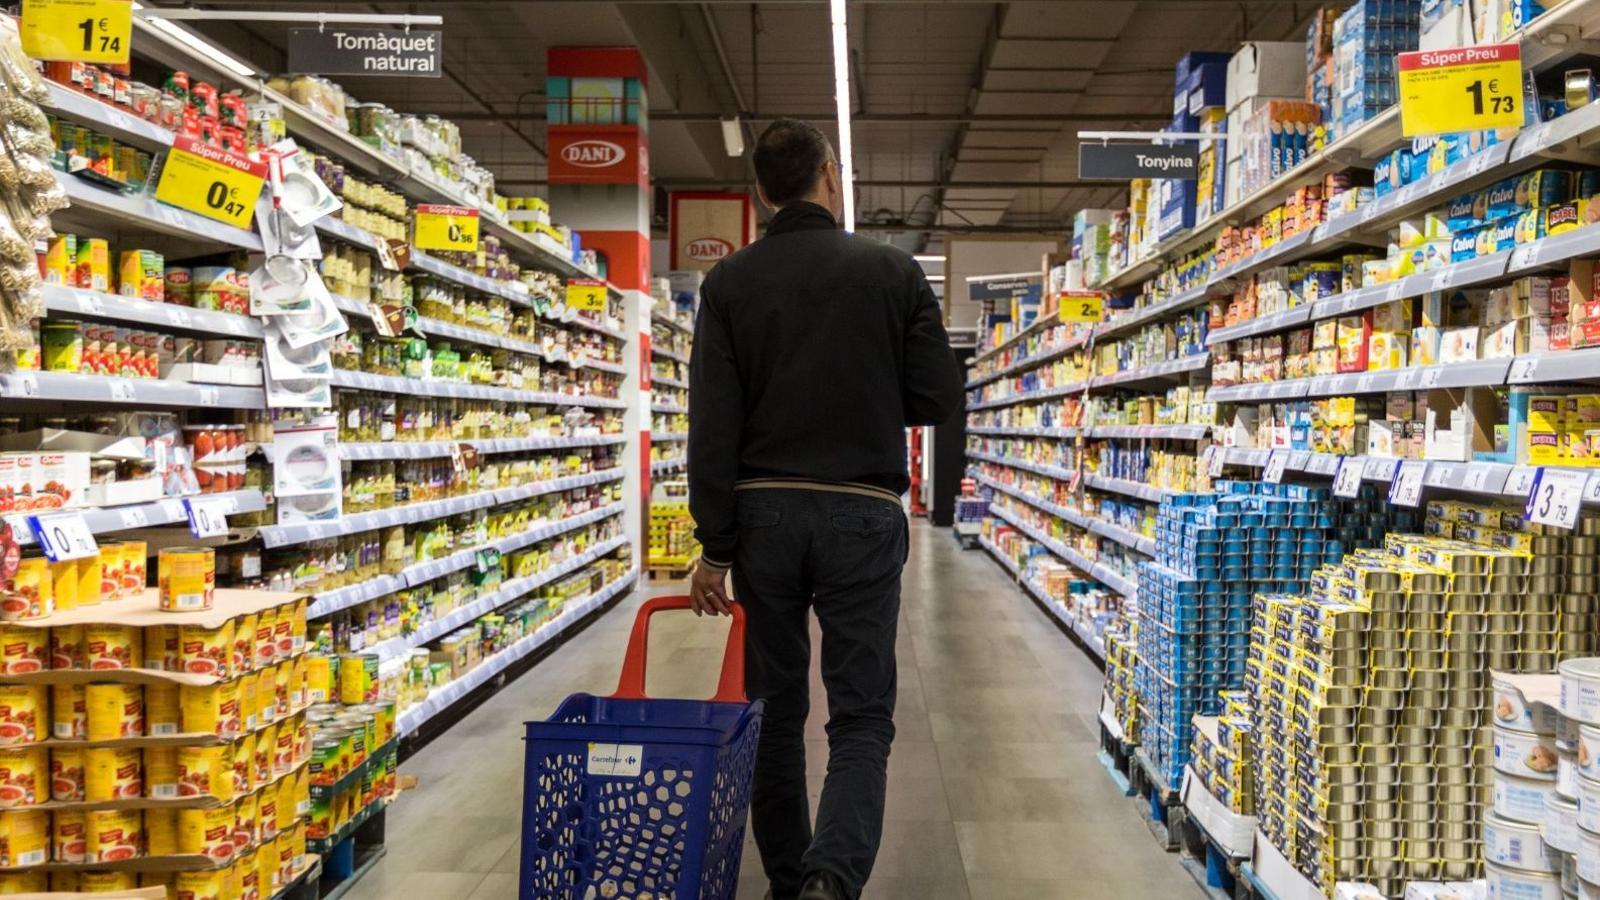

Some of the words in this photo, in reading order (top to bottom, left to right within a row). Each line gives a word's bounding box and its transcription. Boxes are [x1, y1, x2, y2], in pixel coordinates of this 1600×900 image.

[79, 18, 93, 51] 1
[100, 36, 120, 53] 74
[333, 32, 435, 54] Tomàquet
[364, 54, 435, 72] natural
[1421, 52, 1465, 66] Súper
[1466, 49, 1499, 61] Preu
[1466, 80, 1484, 115] 1
[1490, 96, 1514, 114] 73
[190, 142, 223, 161] Súper
[224, 153, 251, 170] Preu
[569, 147, 611, 161] DANI
[1136, 155, 1193, 170] Tonyina
[207, 181, 228, 209] 0
[224, 202, 245, 217] 47
[690, 244, 723, 256] DANI
[1453, 238, 1475, 253] Calvo
[1540, 484, 1555, 518] 3
[1556, 504, 1568, 521] 79
[54, 527, 70, 553] 0
